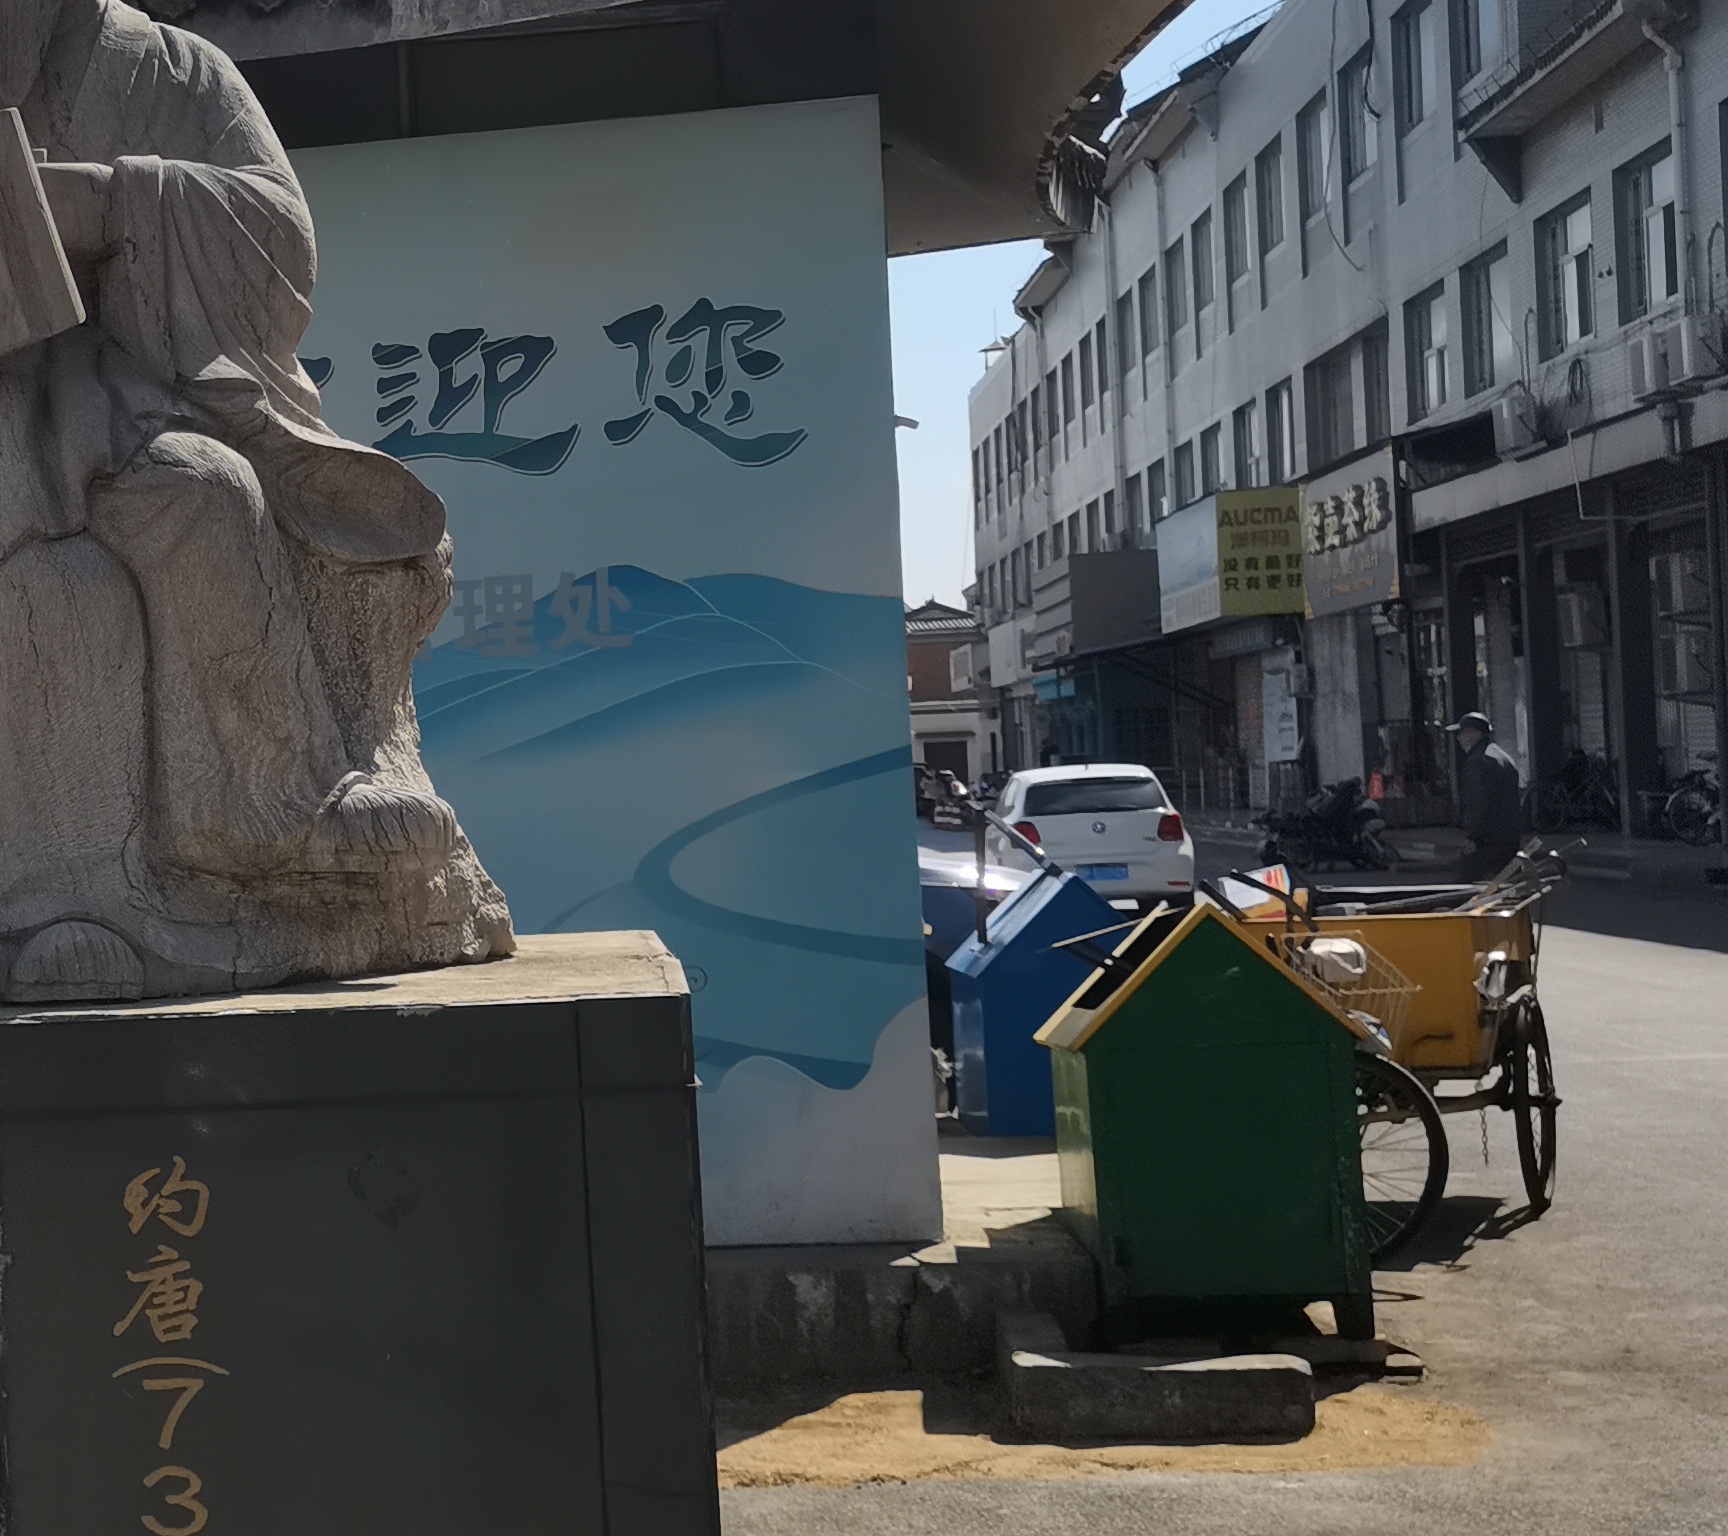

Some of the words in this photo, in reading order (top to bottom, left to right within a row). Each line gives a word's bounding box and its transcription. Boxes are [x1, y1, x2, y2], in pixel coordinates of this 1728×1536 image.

[294, 297, 809, 476] 迎您
[1219, 504, 1300, 529] AUCMA
[412, 566, 634, 662] 理处
